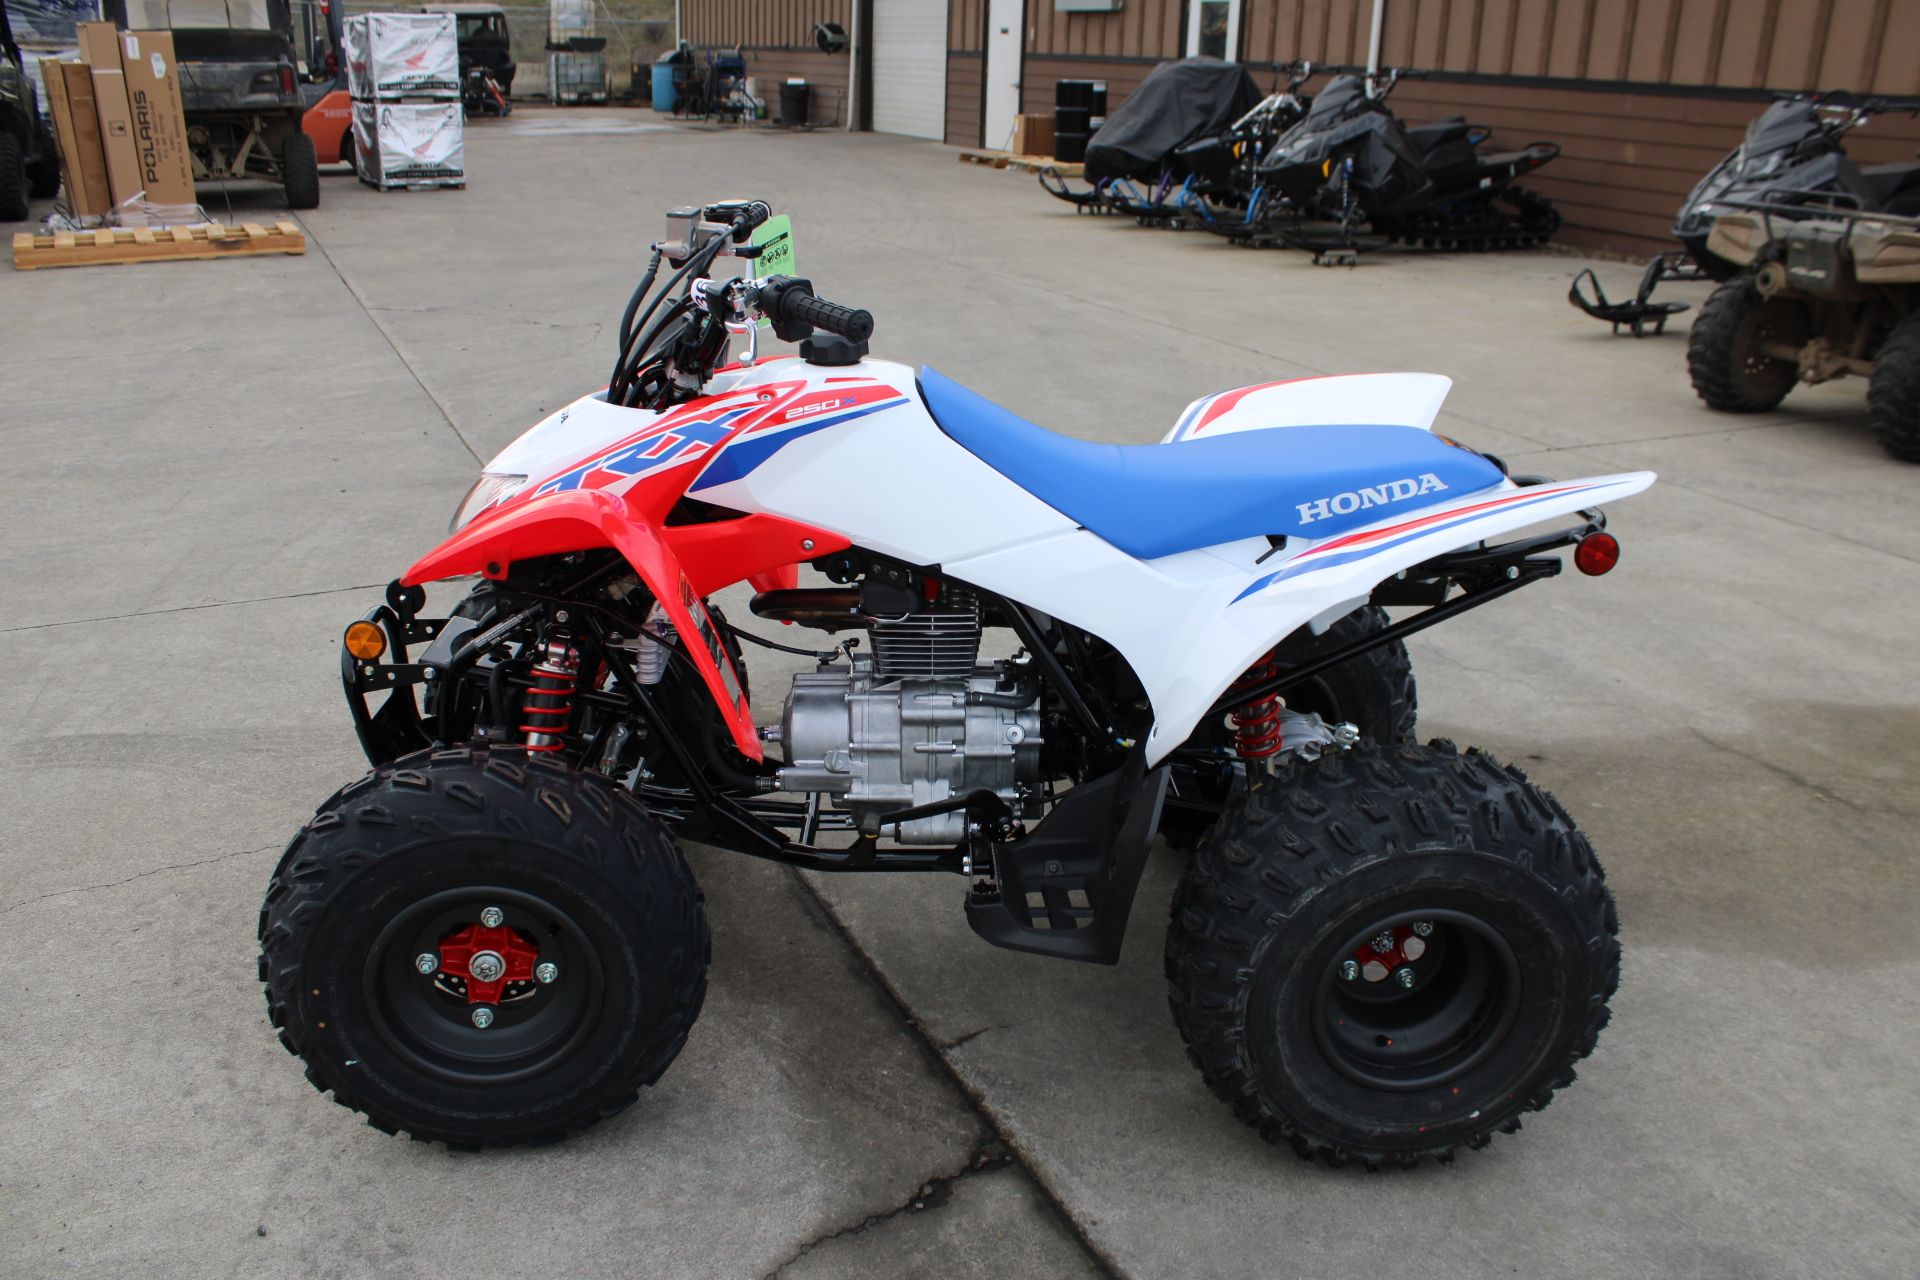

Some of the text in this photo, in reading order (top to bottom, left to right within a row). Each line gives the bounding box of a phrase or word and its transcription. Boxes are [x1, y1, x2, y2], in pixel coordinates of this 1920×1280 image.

[133, 89, 159, 184] POLARIS
[785, 396, 857, 421] 250X
[1296, 472, 1449, 525] HONDA
